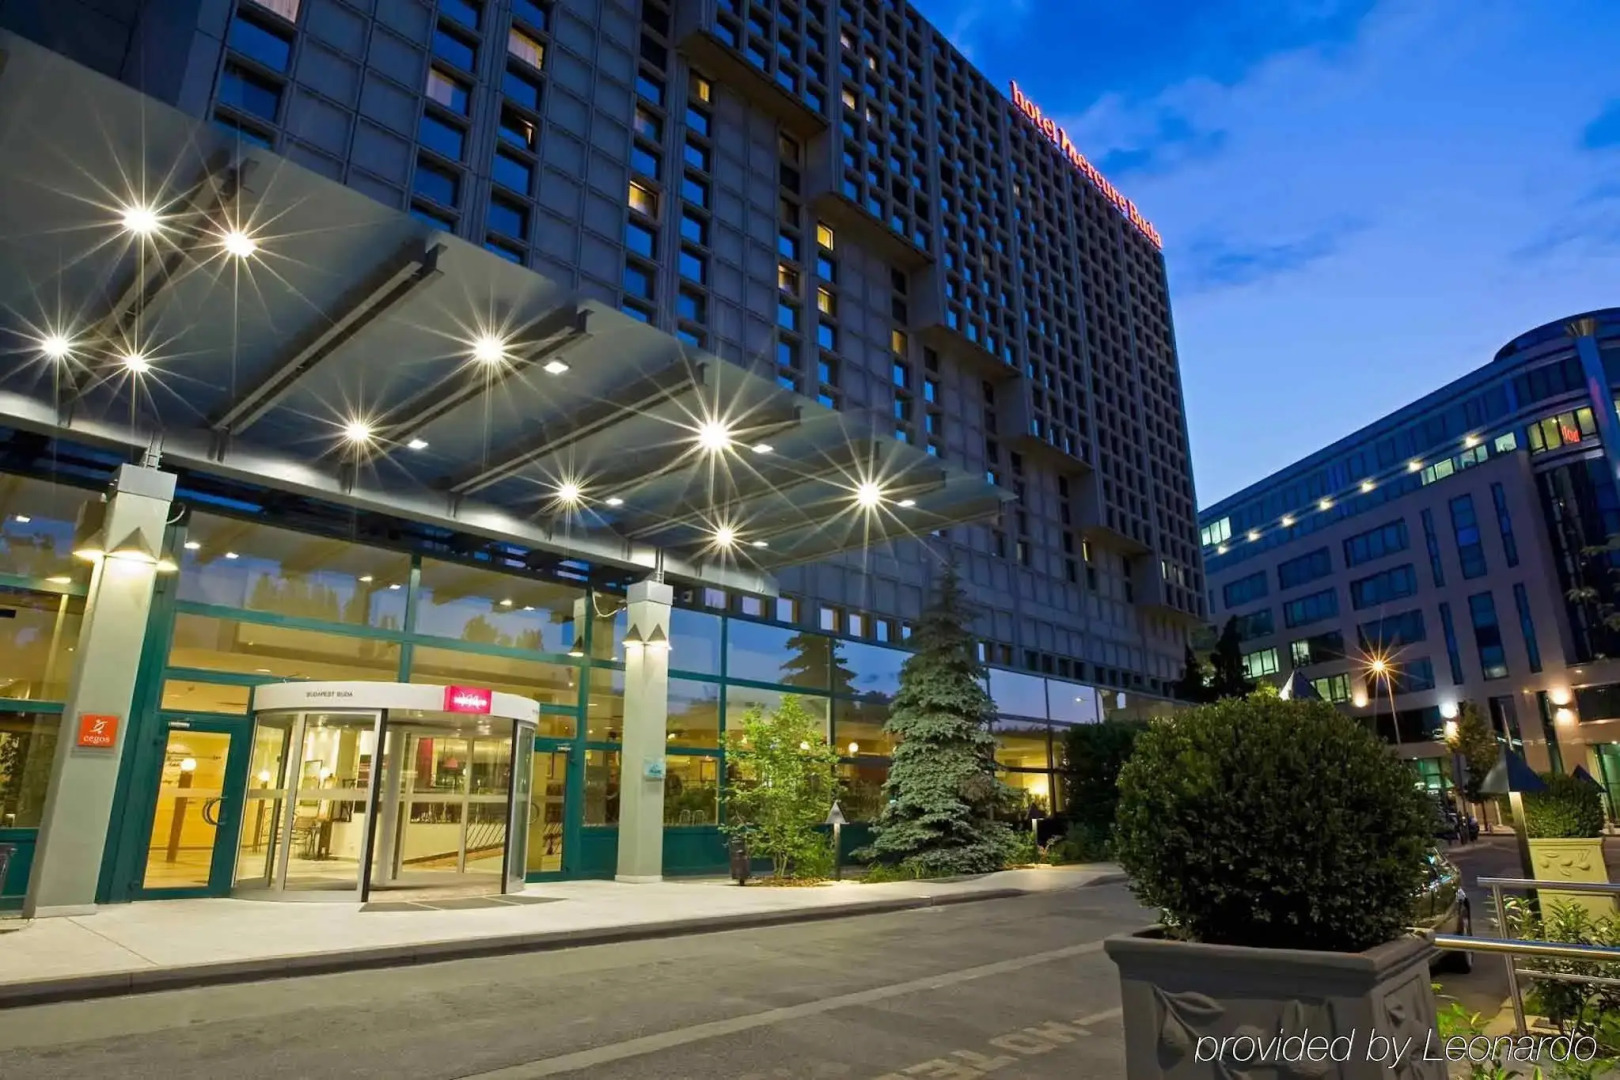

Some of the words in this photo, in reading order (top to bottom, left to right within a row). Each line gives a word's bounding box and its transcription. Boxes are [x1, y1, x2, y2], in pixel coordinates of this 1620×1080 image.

[1010, 80, 1057, 143] hotel
[1127, 199, 1163, 250] Buda
[83, 735, 110, 744] cegos
